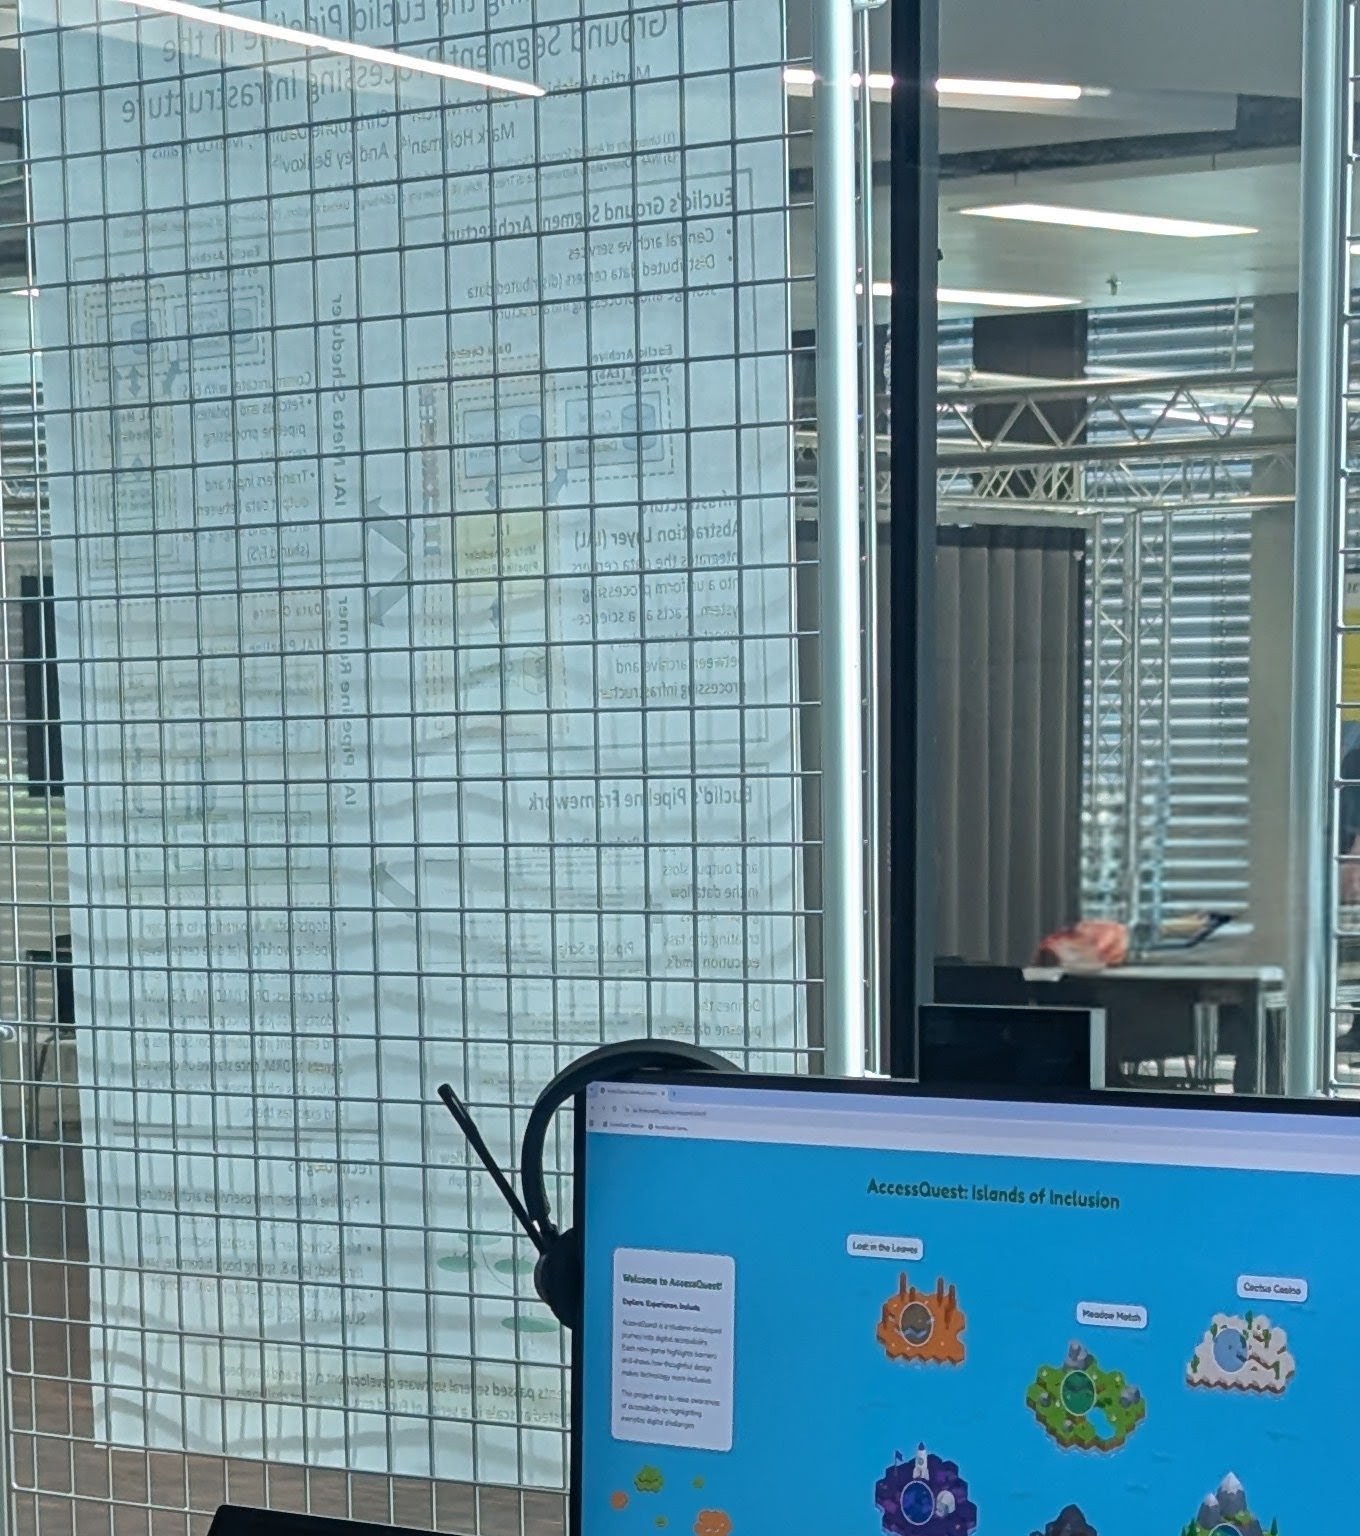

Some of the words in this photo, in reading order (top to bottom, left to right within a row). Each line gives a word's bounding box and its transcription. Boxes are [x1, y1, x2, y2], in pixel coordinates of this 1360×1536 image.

[866, 1177, 969, 1200] AccessQuest:
[971, 1184, 1025, 1205] Islands
[1028, 1186, 1046, 1205] of
[1048, 1188, 1121, 1210] Inclusion
